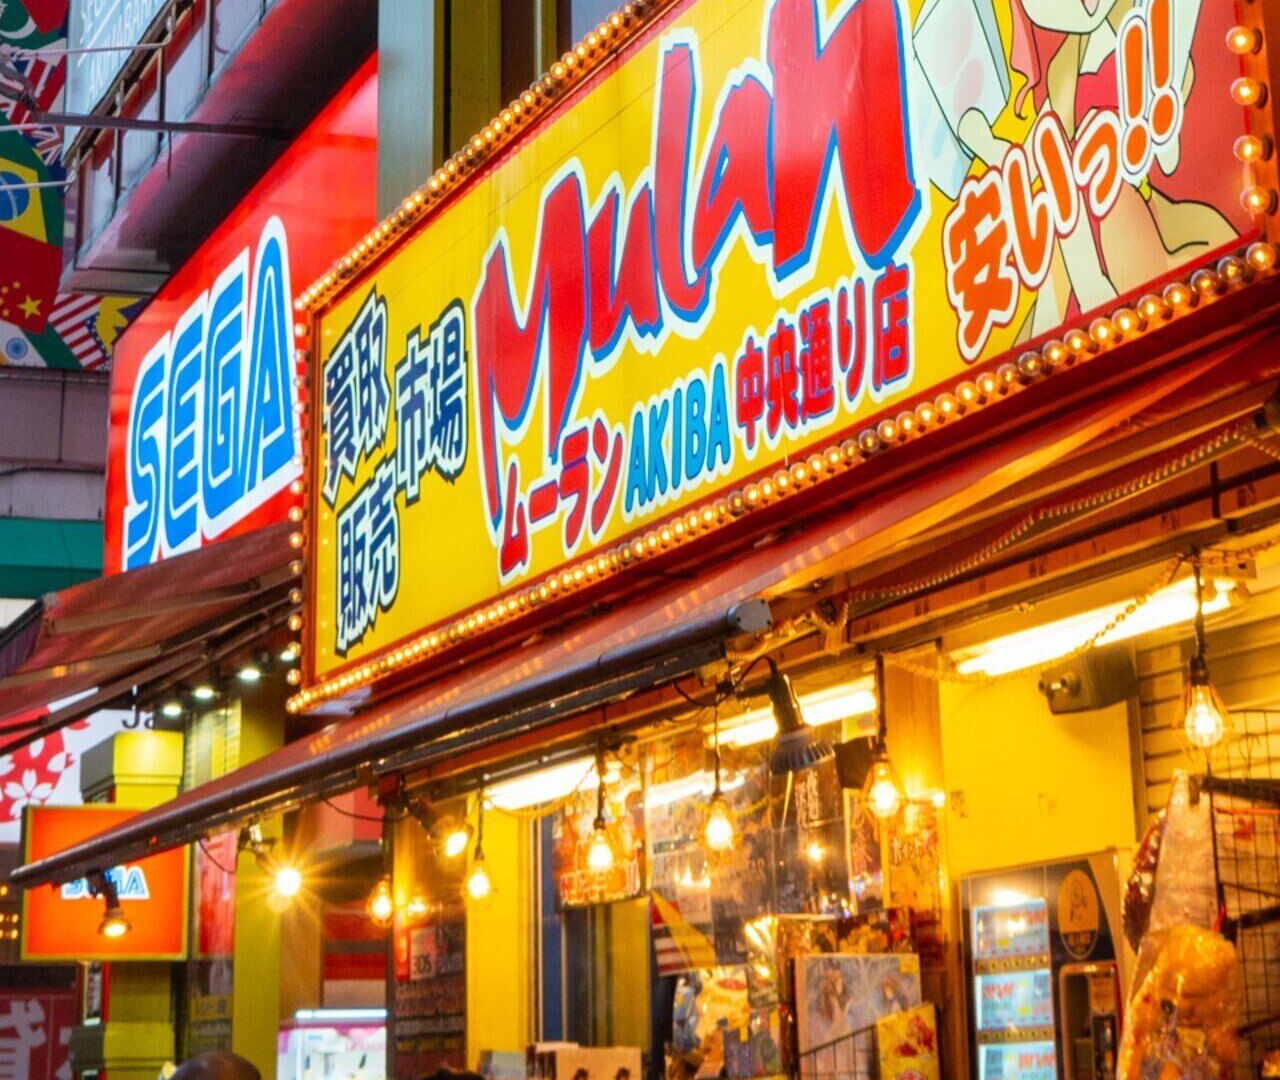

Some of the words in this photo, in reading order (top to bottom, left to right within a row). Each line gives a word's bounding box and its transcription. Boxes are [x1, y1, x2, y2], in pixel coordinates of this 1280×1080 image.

[123, 217, 302, 571] SEGA
[325, 290, 389, 502] 買取
[396, 304, 466, 500] 市場
[501, 422, 623, 576] ムーラン
[624, 365, 731, 513] AKIBA
[736, 263, 911, 449] 中央通り店
[337, 462, 398, 650] 販売
